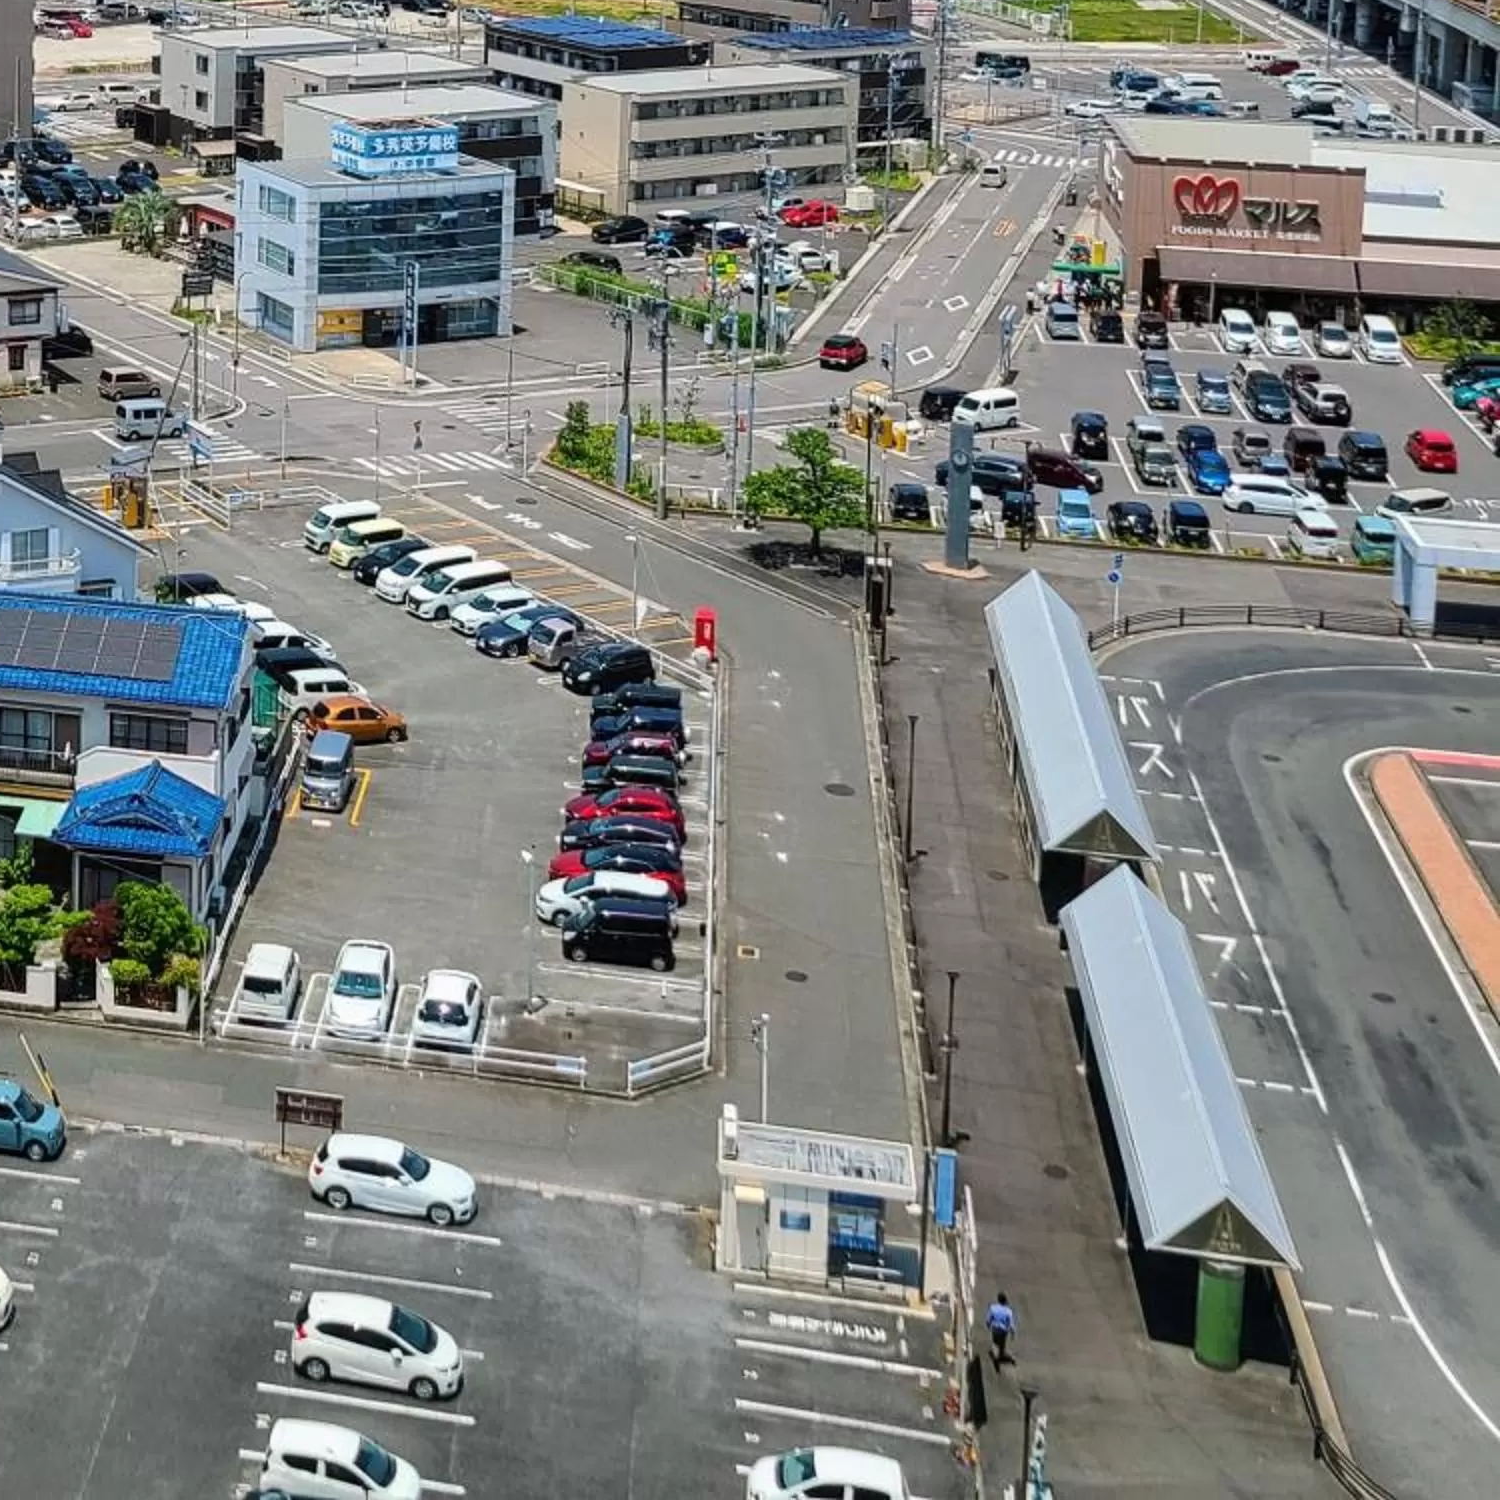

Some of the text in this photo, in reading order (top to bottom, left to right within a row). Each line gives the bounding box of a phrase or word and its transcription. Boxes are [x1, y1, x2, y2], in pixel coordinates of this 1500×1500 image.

[1171, 224, 1214, 237] FOODS
[1215, 226, 1270, 240] MARKET
[1242, 198, 1320, 227] マルス
[1116, 694, 1176, 780] バス
[1178, 869, 1251, 982] バス
